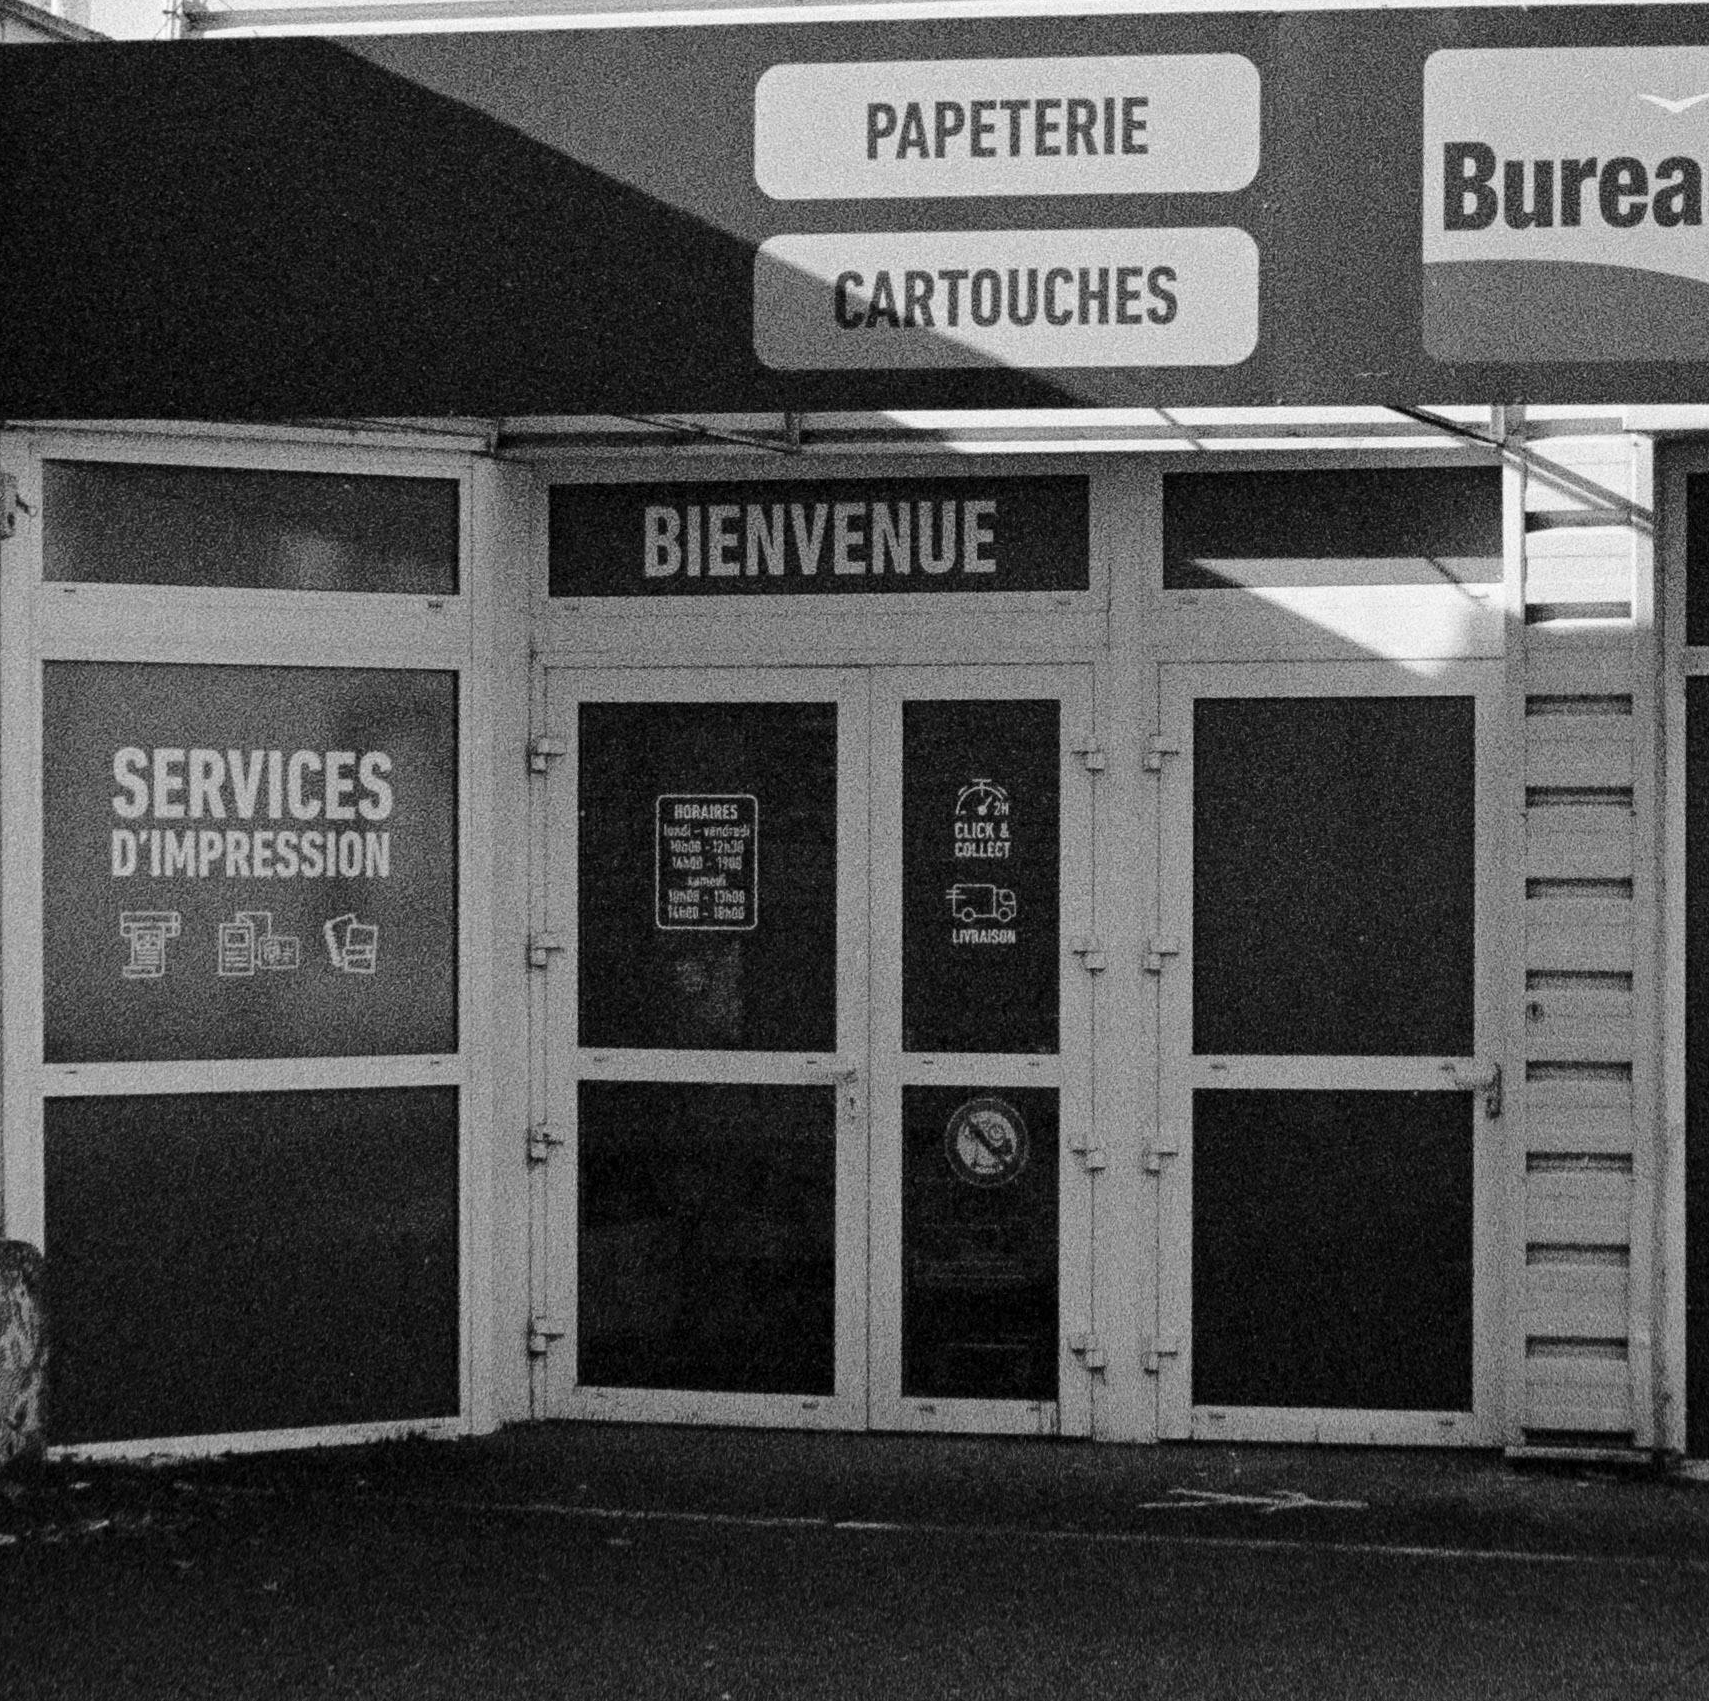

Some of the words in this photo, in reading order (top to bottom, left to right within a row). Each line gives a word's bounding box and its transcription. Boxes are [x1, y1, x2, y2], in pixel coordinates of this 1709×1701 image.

[866, 97, 1149, 160] PAPETERIE
[833, 266, 1179, 331] CARTOUCHES
[644, 500, 998, 578] BIENVENUE
[111, 746, 393, 821] SERVICES
[673, 803, 739, 820] HORAIRES
[993, 802, 1010, 817] 2H
[953, 821, 995, 839] CLICK
[999, 821, 1010, 839] &
[110, 828, 392, 878] D'IMPRESSION
[953, 841, 1012, 858] COLLECT
[951, 928, 1016, 945] LIVRAISON
